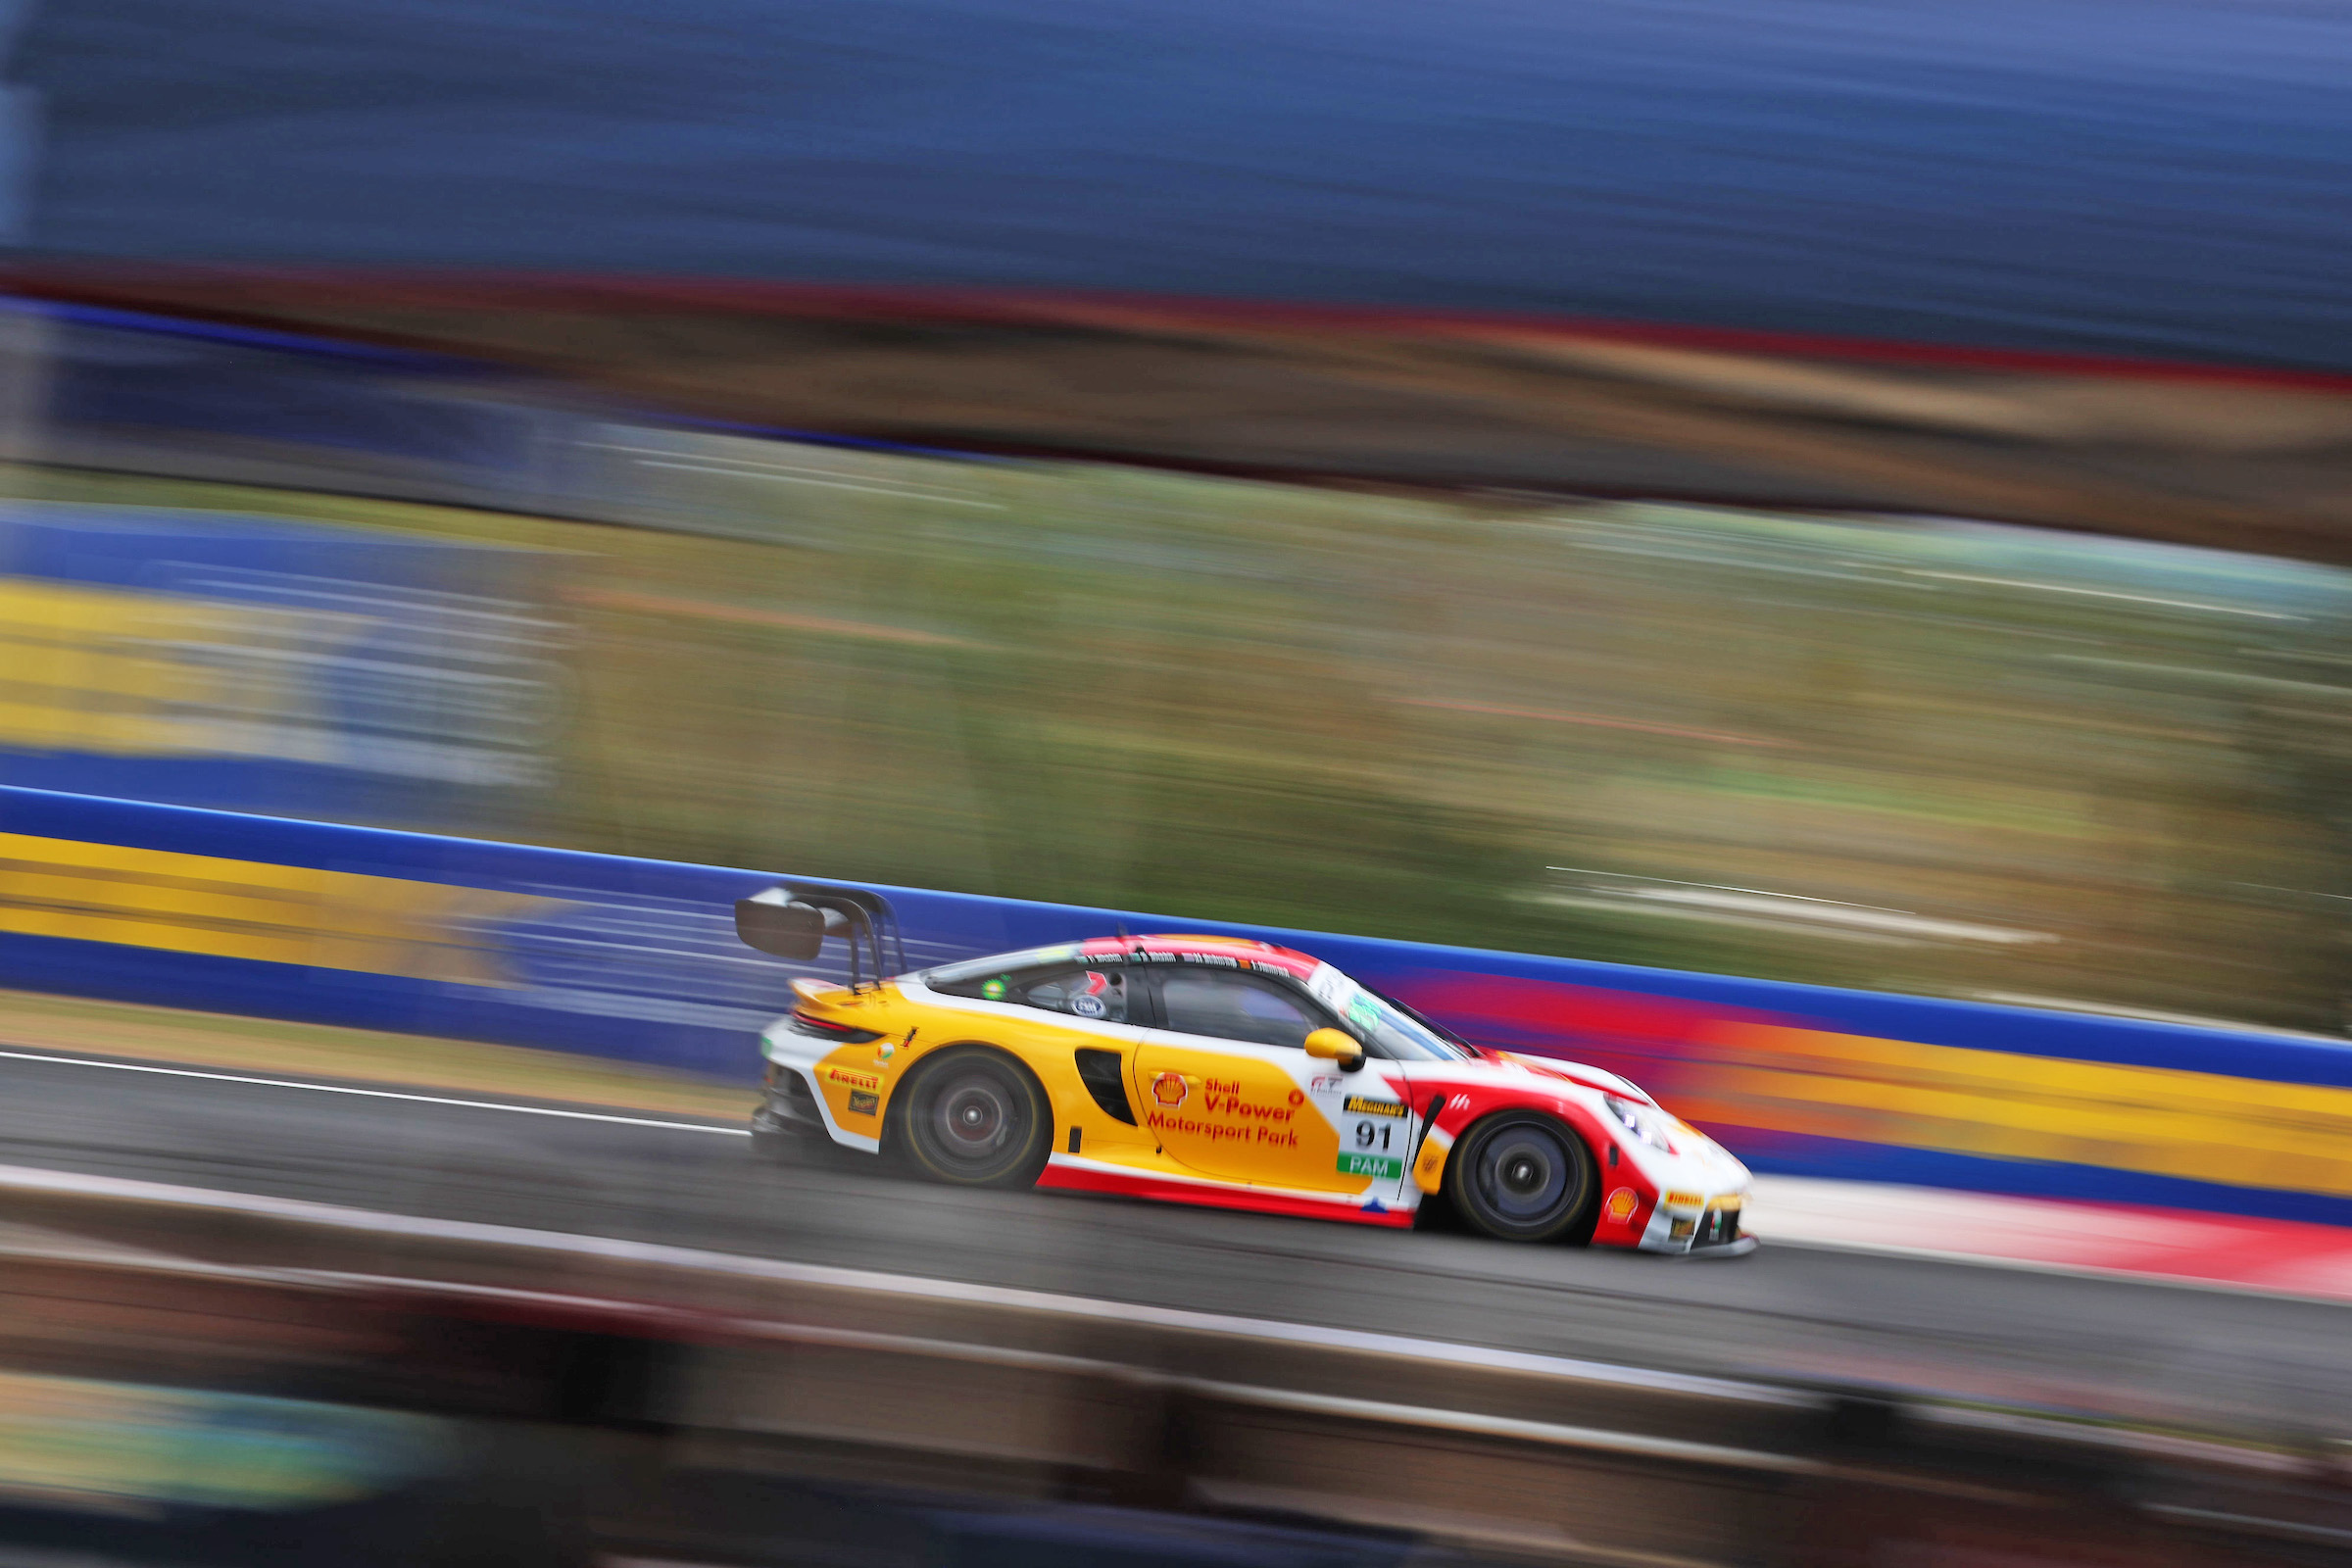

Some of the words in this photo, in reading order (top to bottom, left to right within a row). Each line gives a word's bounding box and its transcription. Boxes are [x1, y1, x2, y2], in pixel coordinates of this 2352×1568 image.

[829, 1068, 879, 1090] PIRELLI
[1204, 1078, 1241, 1096] Shell
[1204, 1093, 1296, 1122] V-Power
[1148, 1110, 1251, 1142] Motorsport
[1256, 1125, 1299, 1148] Park
[1355, 1119, 1393, 1152] 91
[1349, 1155, 1389, 1176] PAM
